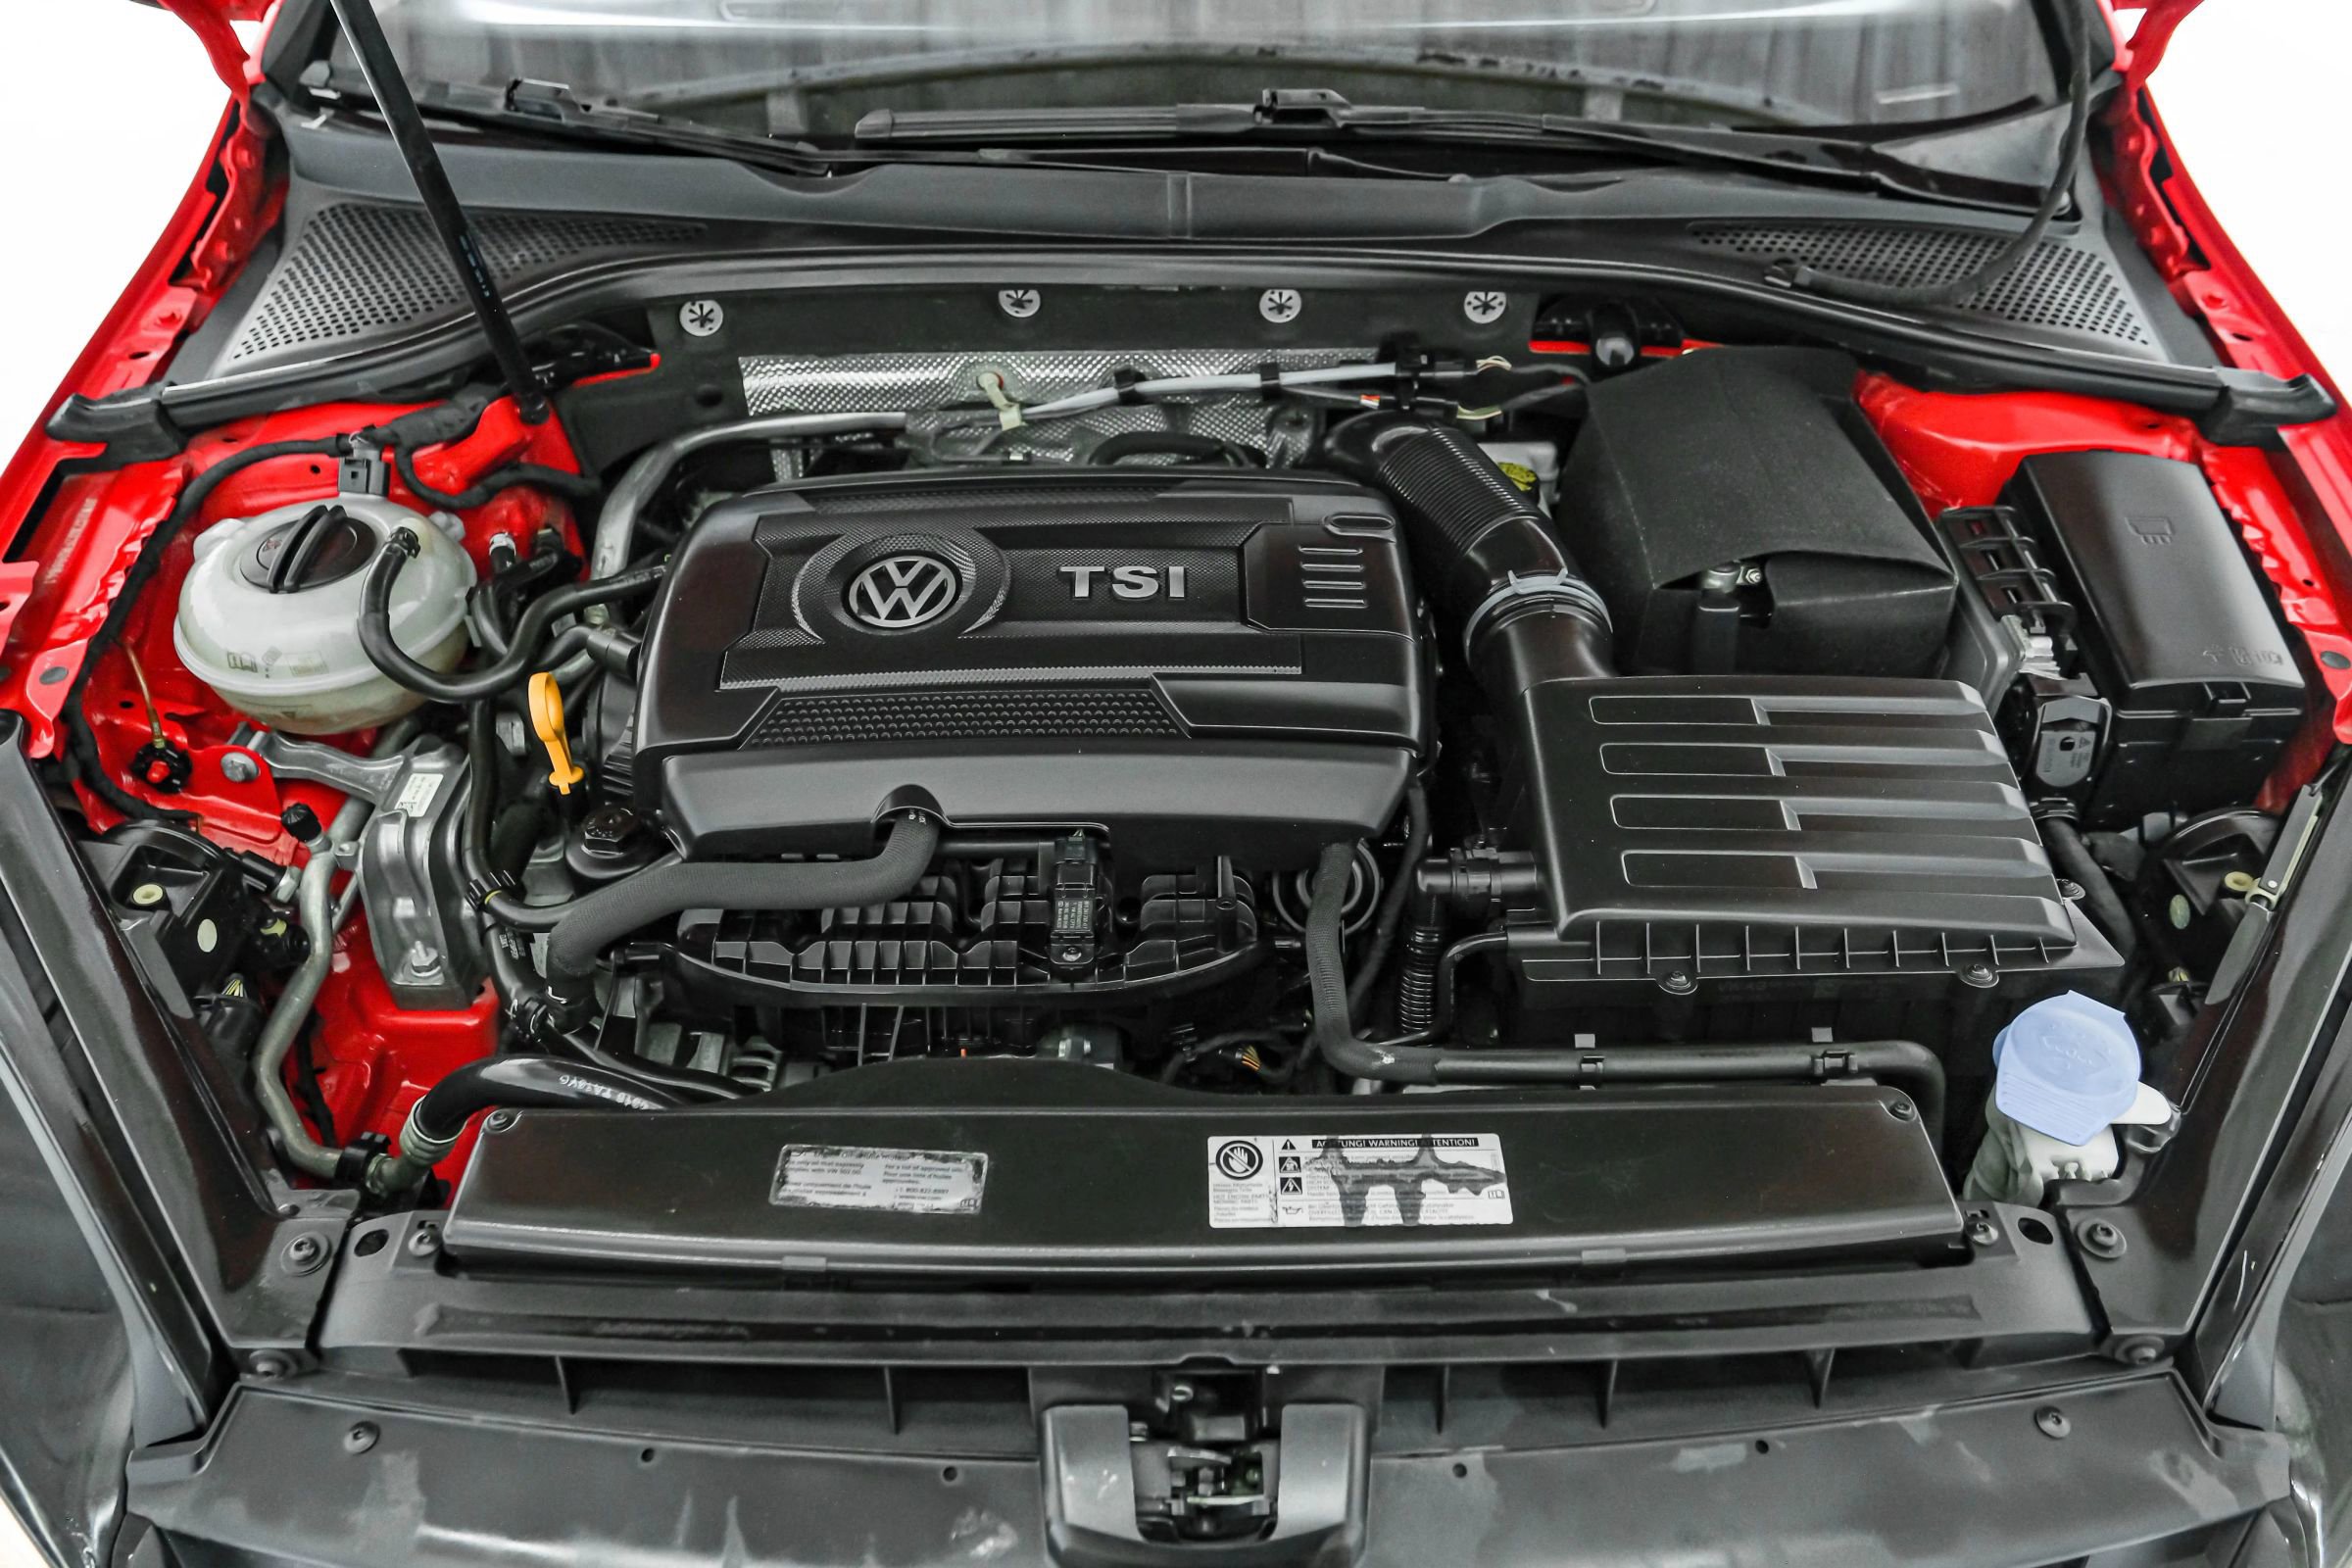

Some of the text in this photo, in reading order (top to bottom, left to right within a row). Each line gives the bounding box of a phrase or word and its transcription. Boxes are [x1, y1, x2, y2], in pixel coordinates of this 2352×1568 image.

[849, 555, 956, 628] VW
[1060, 565, 1185, 598] TSI
[1368, 1139, 1418, 1148] WARNING!
[1423, 1138, 1475, 1147] TENTION!
